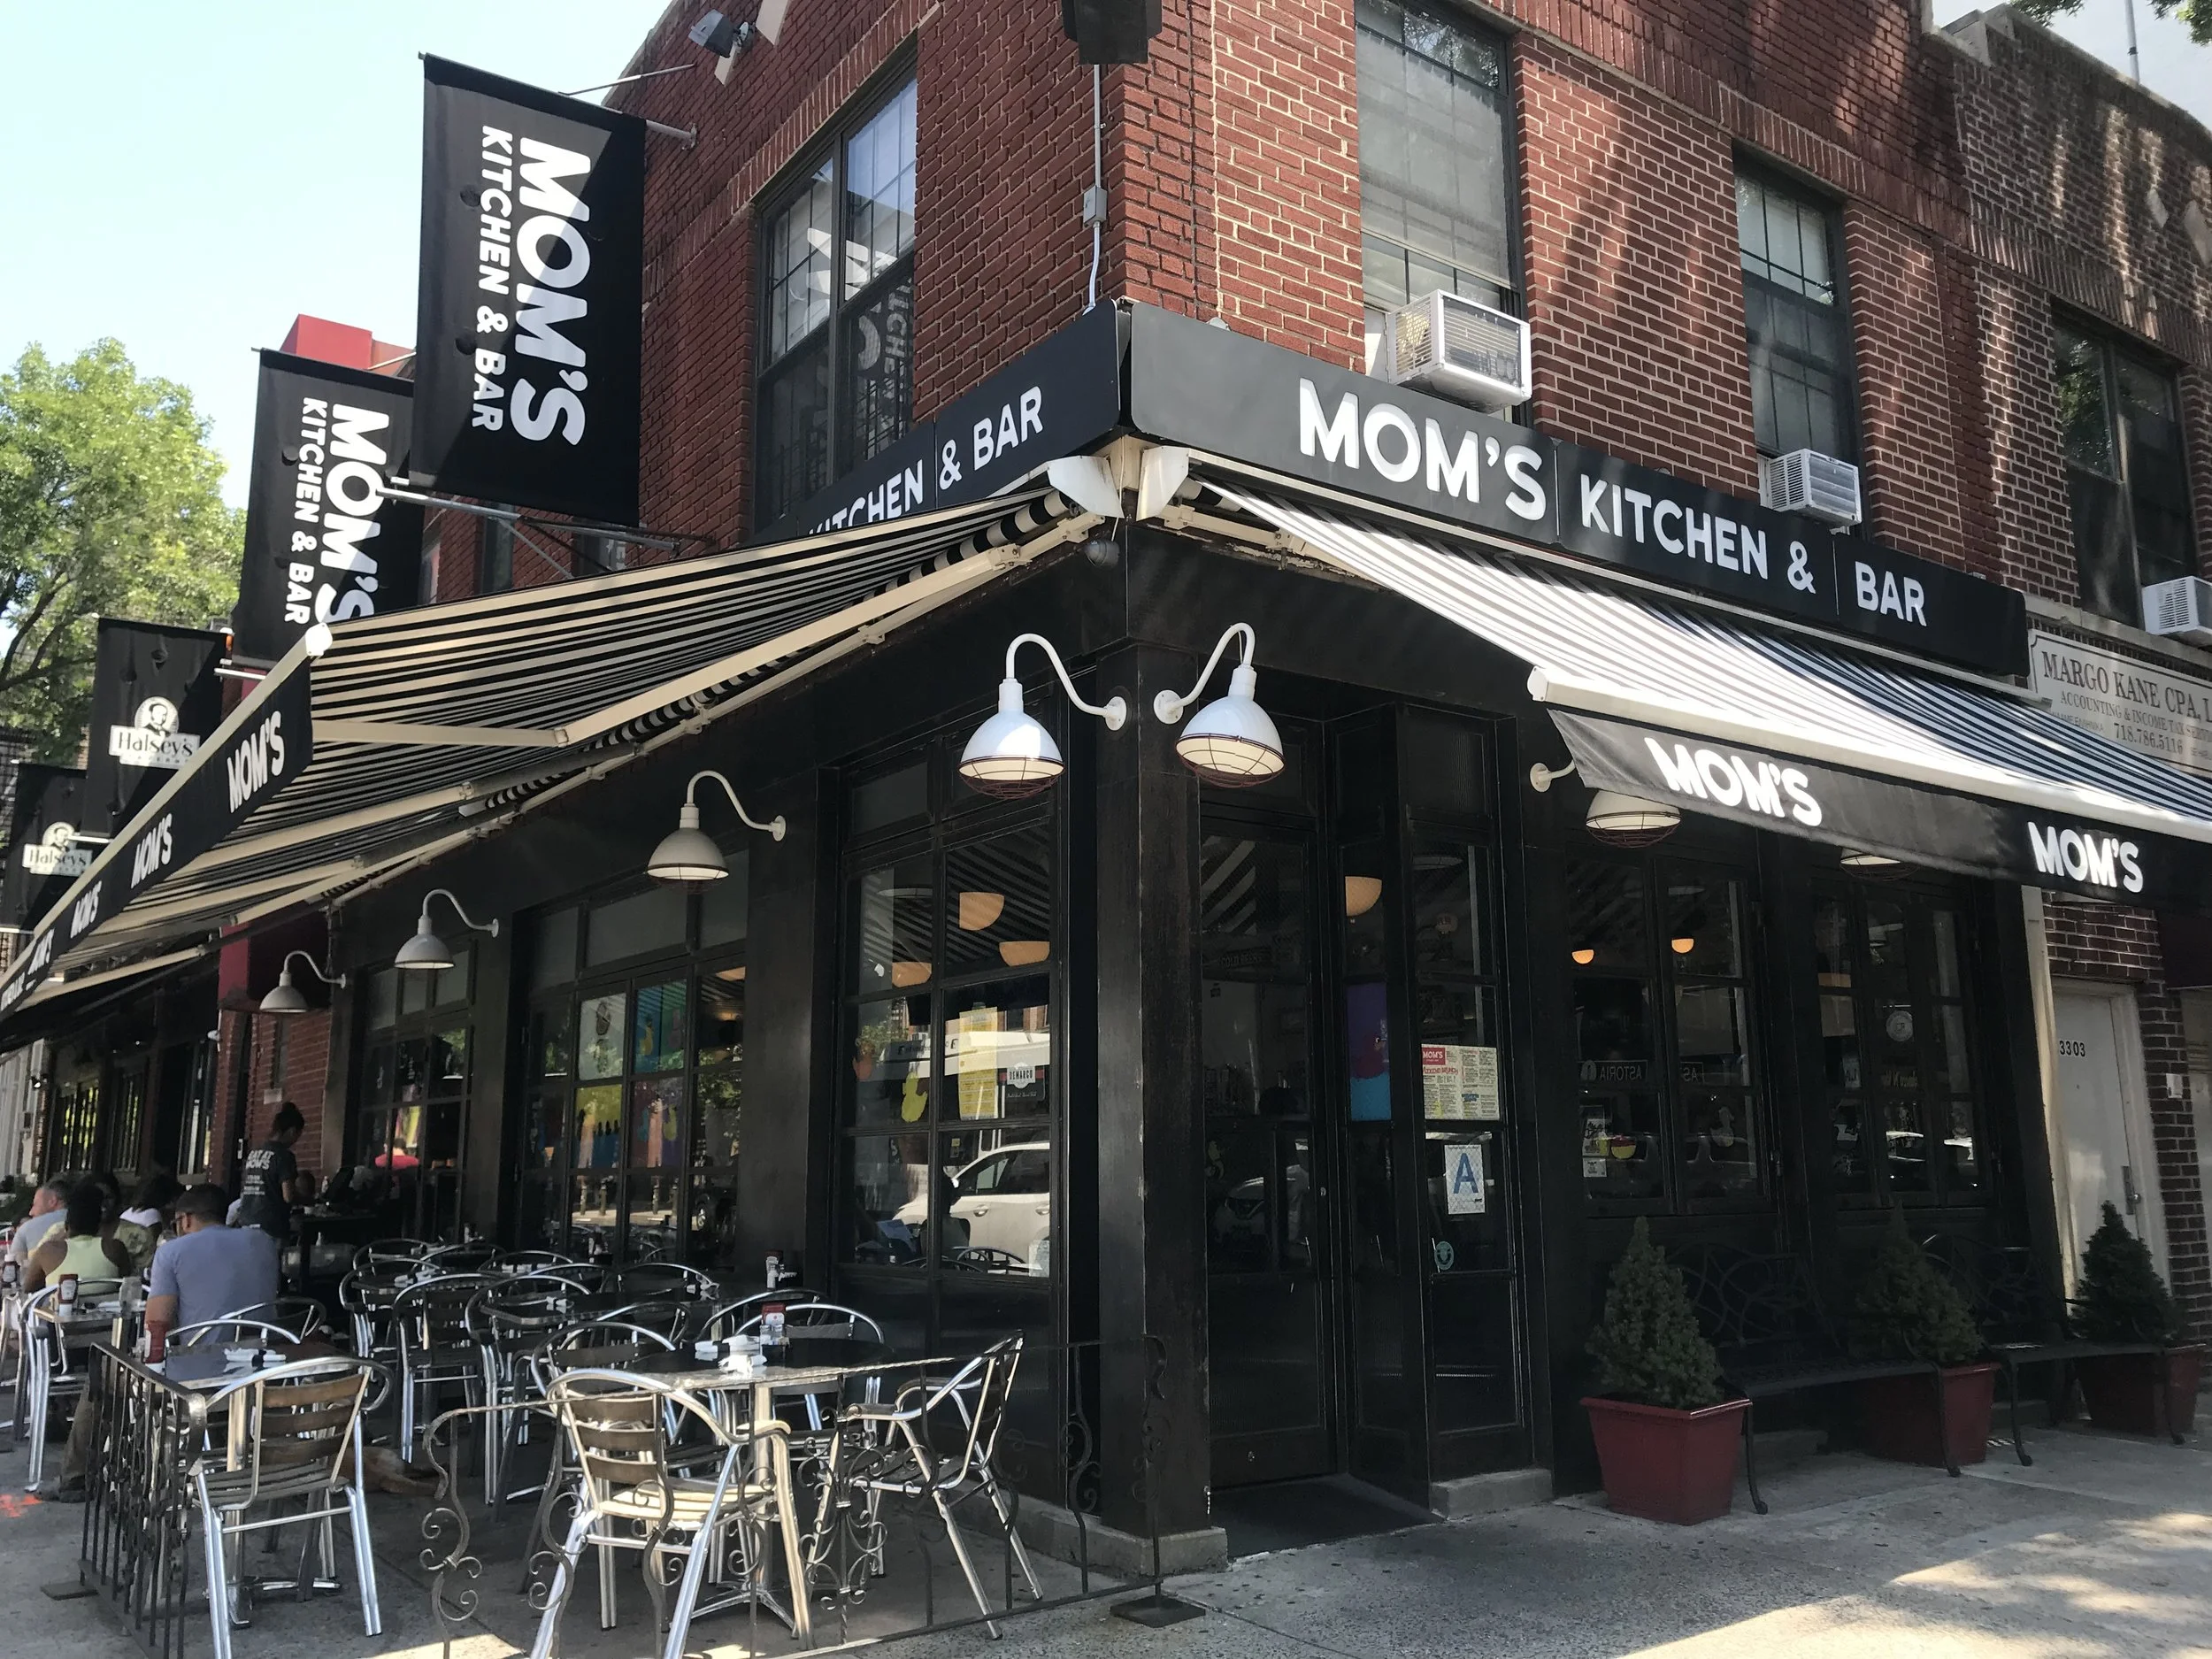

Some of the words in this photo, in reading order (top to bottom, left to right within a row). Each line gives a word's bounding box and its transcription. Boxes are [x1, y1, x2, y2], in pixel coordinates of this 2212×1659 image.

[478, 125, 513, 296] KITCHEN
[476, 304, 508, 334] &
[510, 136, 592, 447] MOM'S
[472, 349, 507, 433] BAR
[294, 396, 328, 525] KITCHEN
[939, 439, 962, 490] &
[973, 385, 1043, 472] BAR
[1298, 377, 1547, 520] MOM'S
[1580, 473, 1769, 580] KITCHEN
[1787, 540, 1816, 595] &
[1855, 560, 1927, 627] BAR
[291, 530, 318, 552] &
[284, 562, 315, 625] BAR
[2042, 651, 2109, 694] MARGO
[2113, 672, 2160, 709] KANE
[2061, 691, 2122, 718] ACCOUNTING
[2124, 710, 2131, 721] &
[2132, 710, 2167, 731] INCOME
[2168, 720, 2185, 734] TAX
[119, 732, 193, 757] Halsey's
[227, 710, 285, 813] MOM'S
[2114, 723, 2184, 754] 718.786.5116
[1644, 737, 1823, 826] MOM'S
[132, 812, 173, 889] MOM'S
[2027, 821, 2144, 893] MOM'S
[2059, 1040, 2085, 1057] 3303
[1453, 1153, 1479, 1194] A
